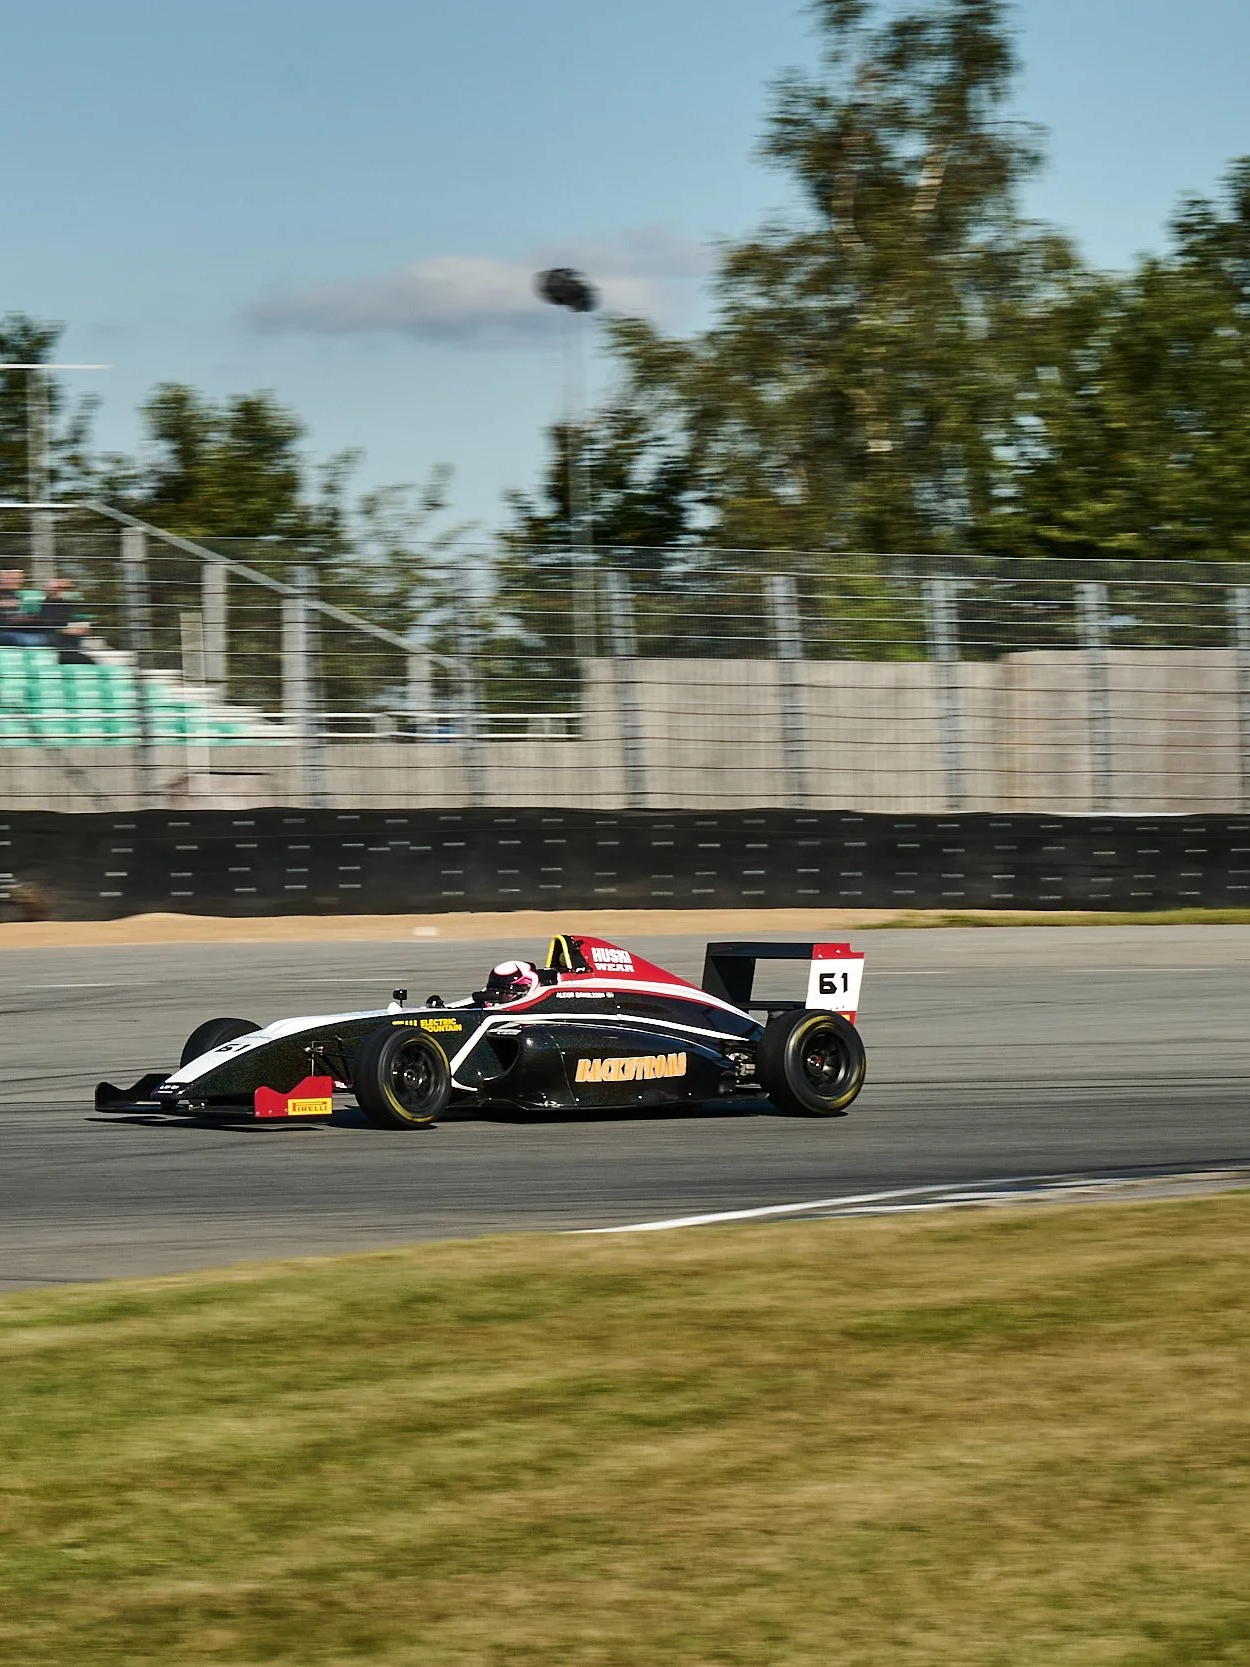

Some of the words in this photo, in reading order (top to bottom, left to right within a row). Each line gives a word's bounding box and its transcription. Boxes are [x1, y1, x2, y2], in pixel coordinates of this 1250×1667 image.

[591, 947, 632, 963] HUSKI
[594, 963, 635, 972] WEAR
[420, 1018, 456, 1026] ELECTRIC
[292, 1101, 327, 1112] PIRELLI
